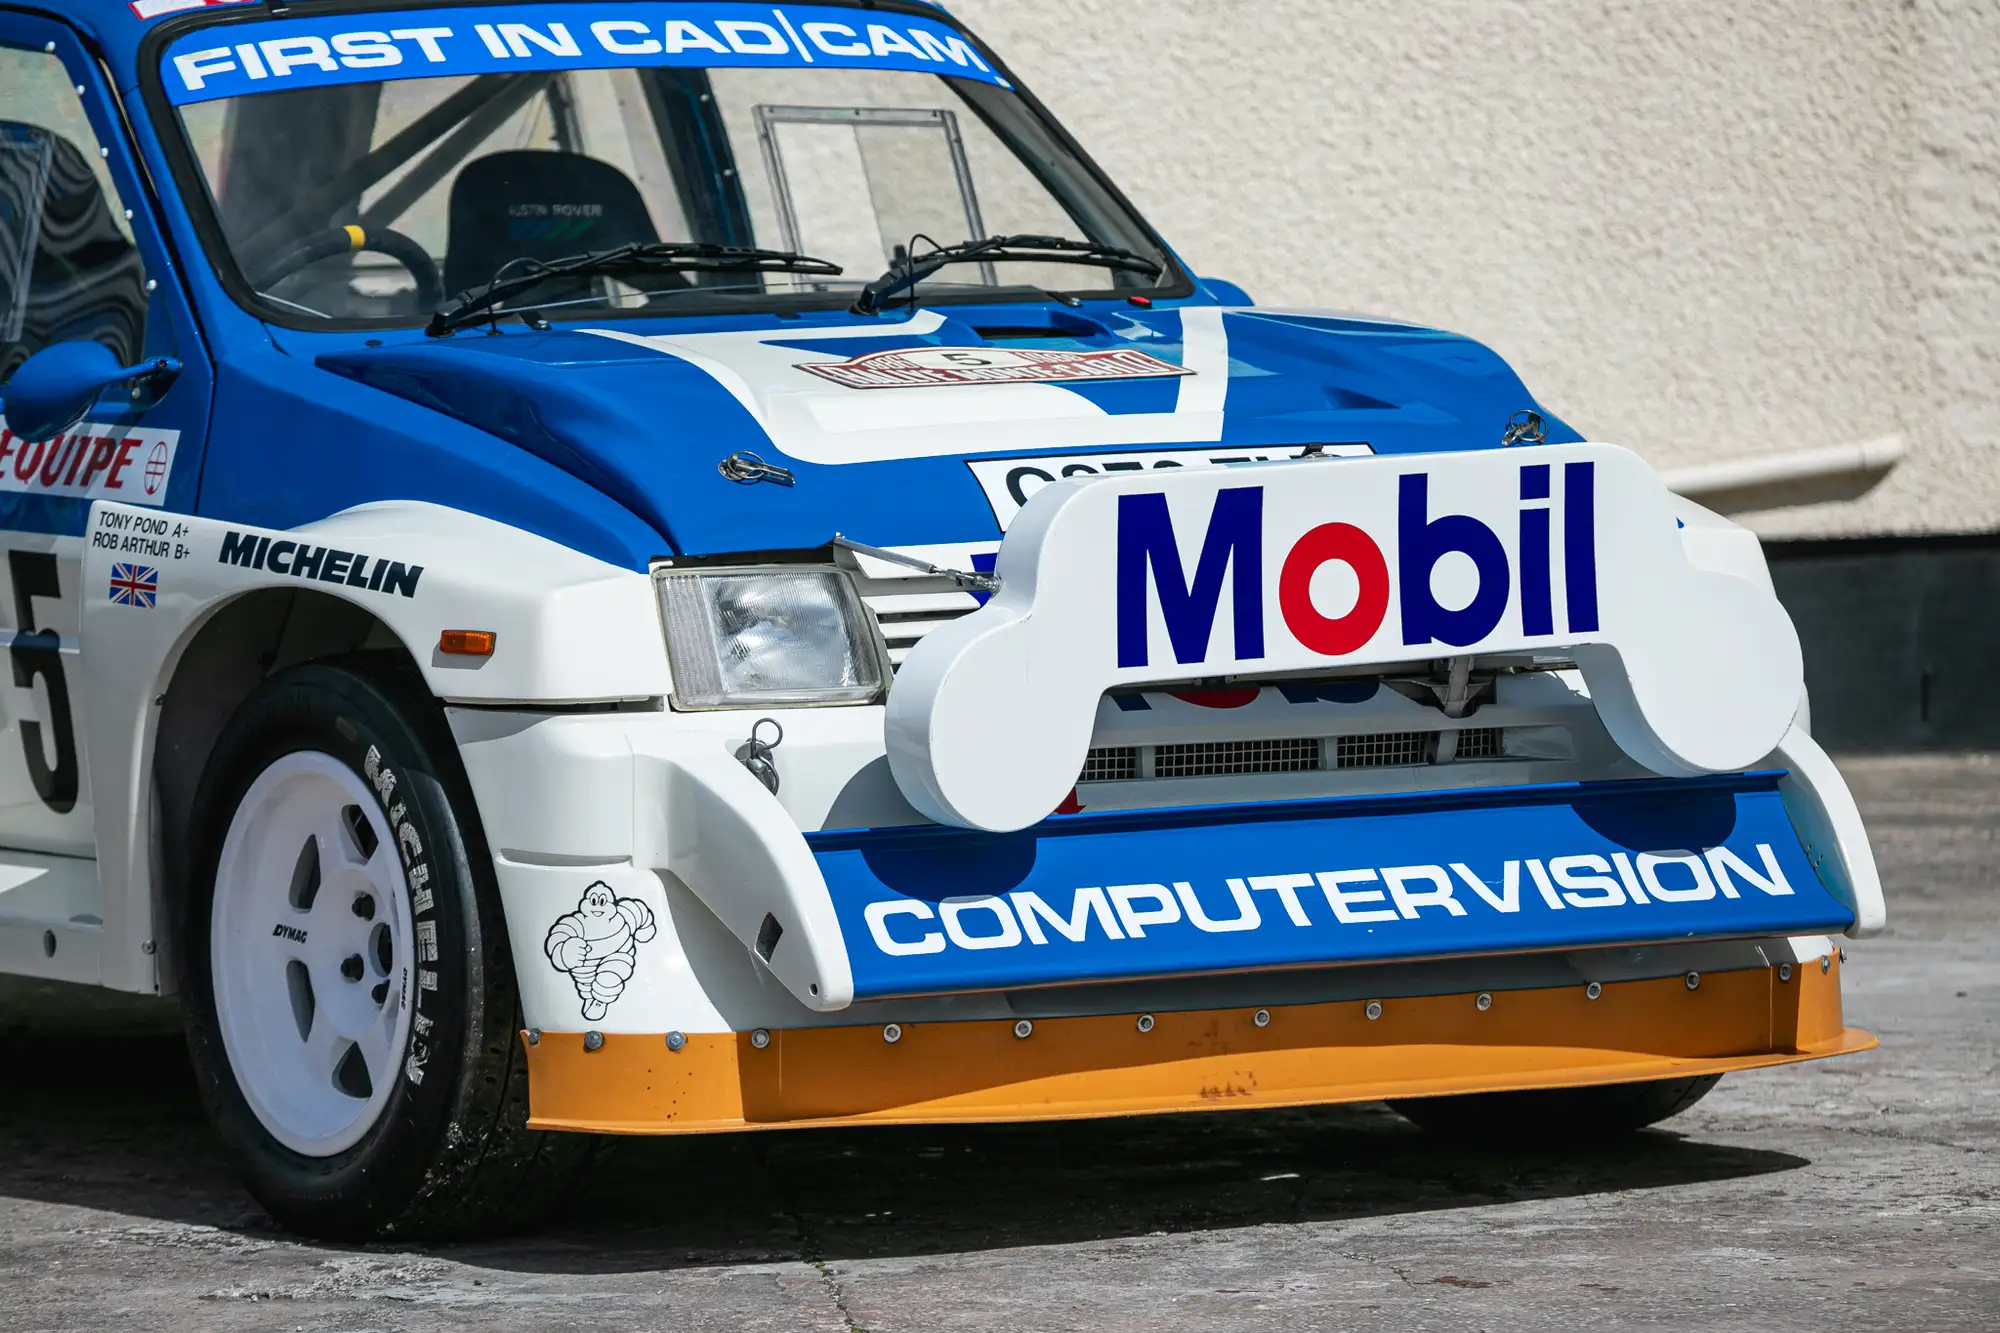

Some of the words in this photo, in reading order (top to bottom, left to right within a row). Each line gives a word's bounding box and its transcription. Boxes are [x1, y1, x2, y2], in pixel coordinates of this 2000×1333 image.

[172, 26, 454, 91] FIRST
[475, 23, 582, 59] IN
[818, 366, 960, 384] RALLYE
[940, 353, 993, 366] 5
[92, 531, 119, 550] ROB
[120, 536, 170, 558] ARTHUR
[174, 544, 191, 560] B+
[100, 511, 133, 530] TONY
[133, 516, 169, 535] POND
[172, 522, 190, 538] A+
[218, 531, 424, 598] MICHELIN
[1117, 461, 1600, 668] Mobil
[9, 549, 79, 815] 5
[864, 843, 1795, 957] COMPUTERVISION
[272, 923, 308, 944] DYMAG
